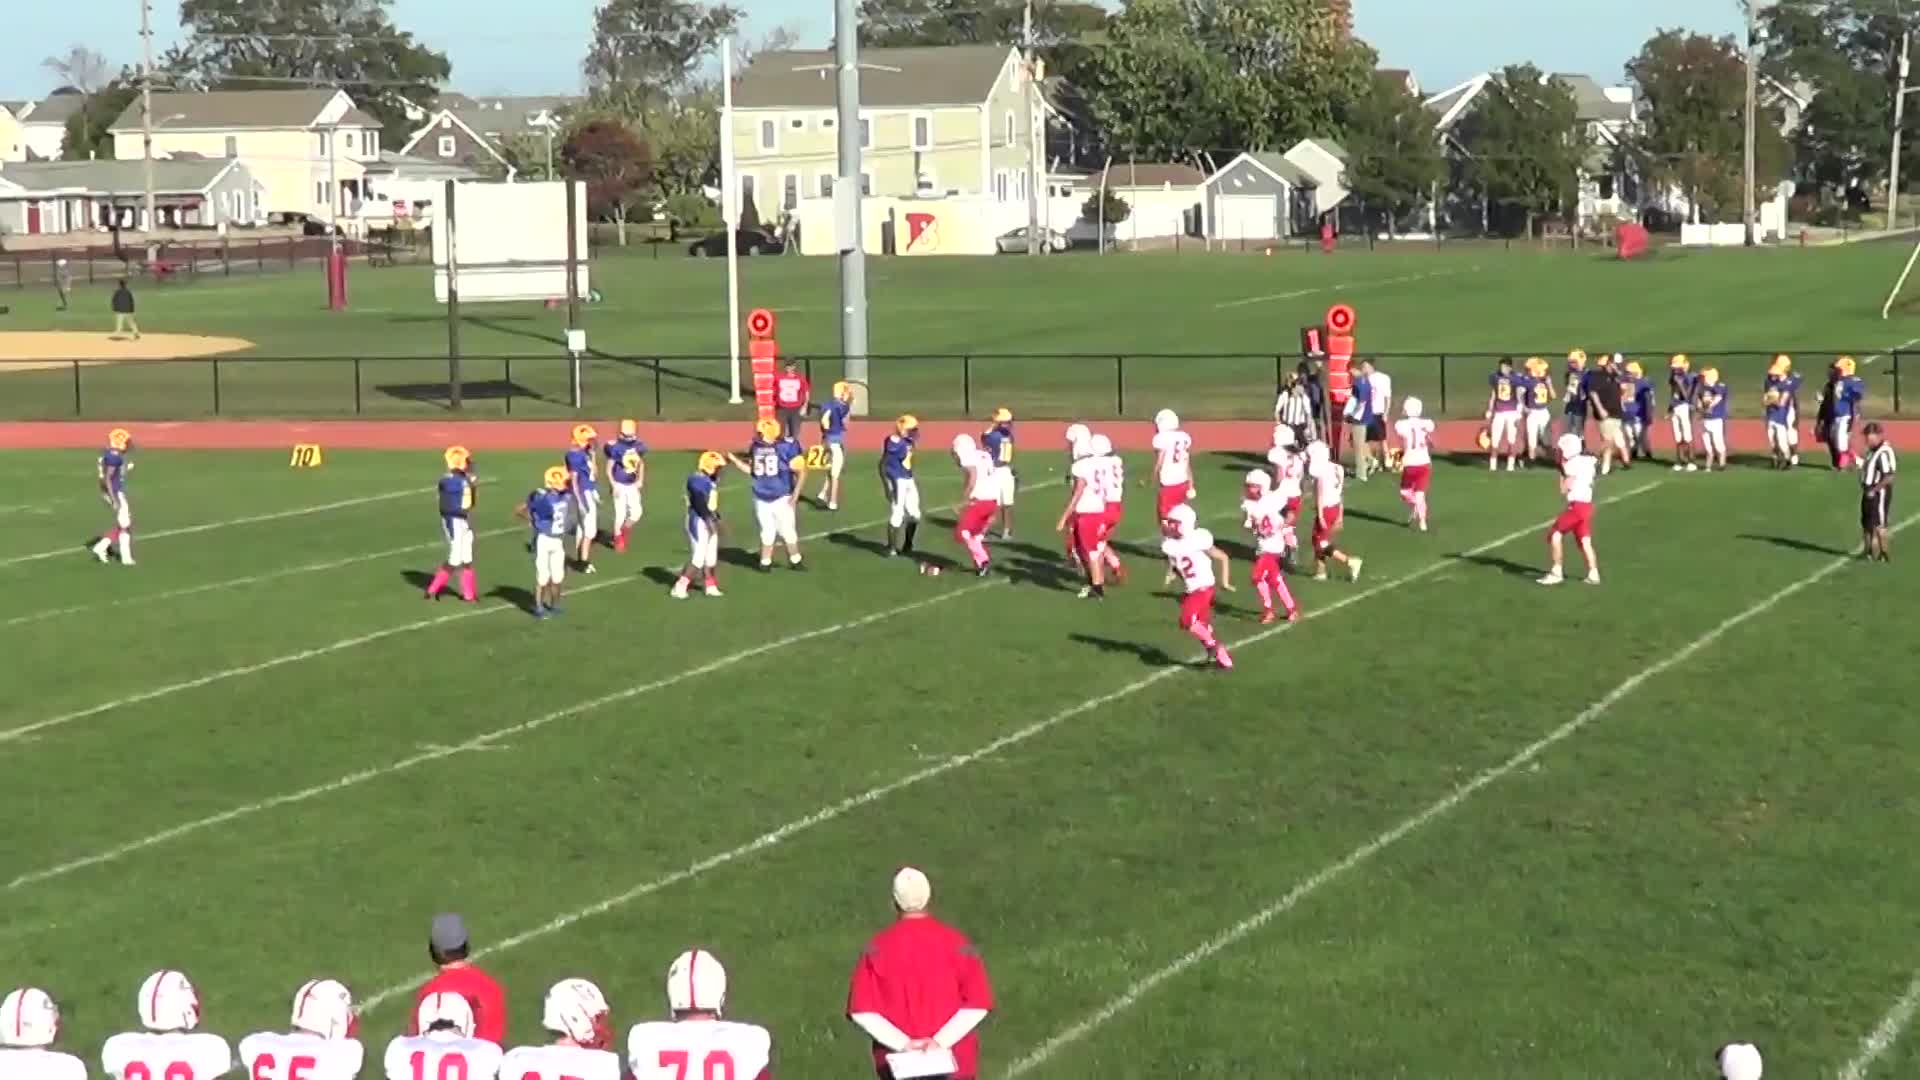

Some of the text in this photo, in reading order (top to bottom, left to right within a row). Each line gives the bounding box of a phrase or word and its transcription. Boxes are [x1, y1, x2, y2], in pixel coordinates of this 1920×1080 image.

[296, 447, 314, 465] 10
[754, 454, 778, 476] 58
[407, 1051, 467, 1080] 10
[658, 1050, 735, 1080] 70
